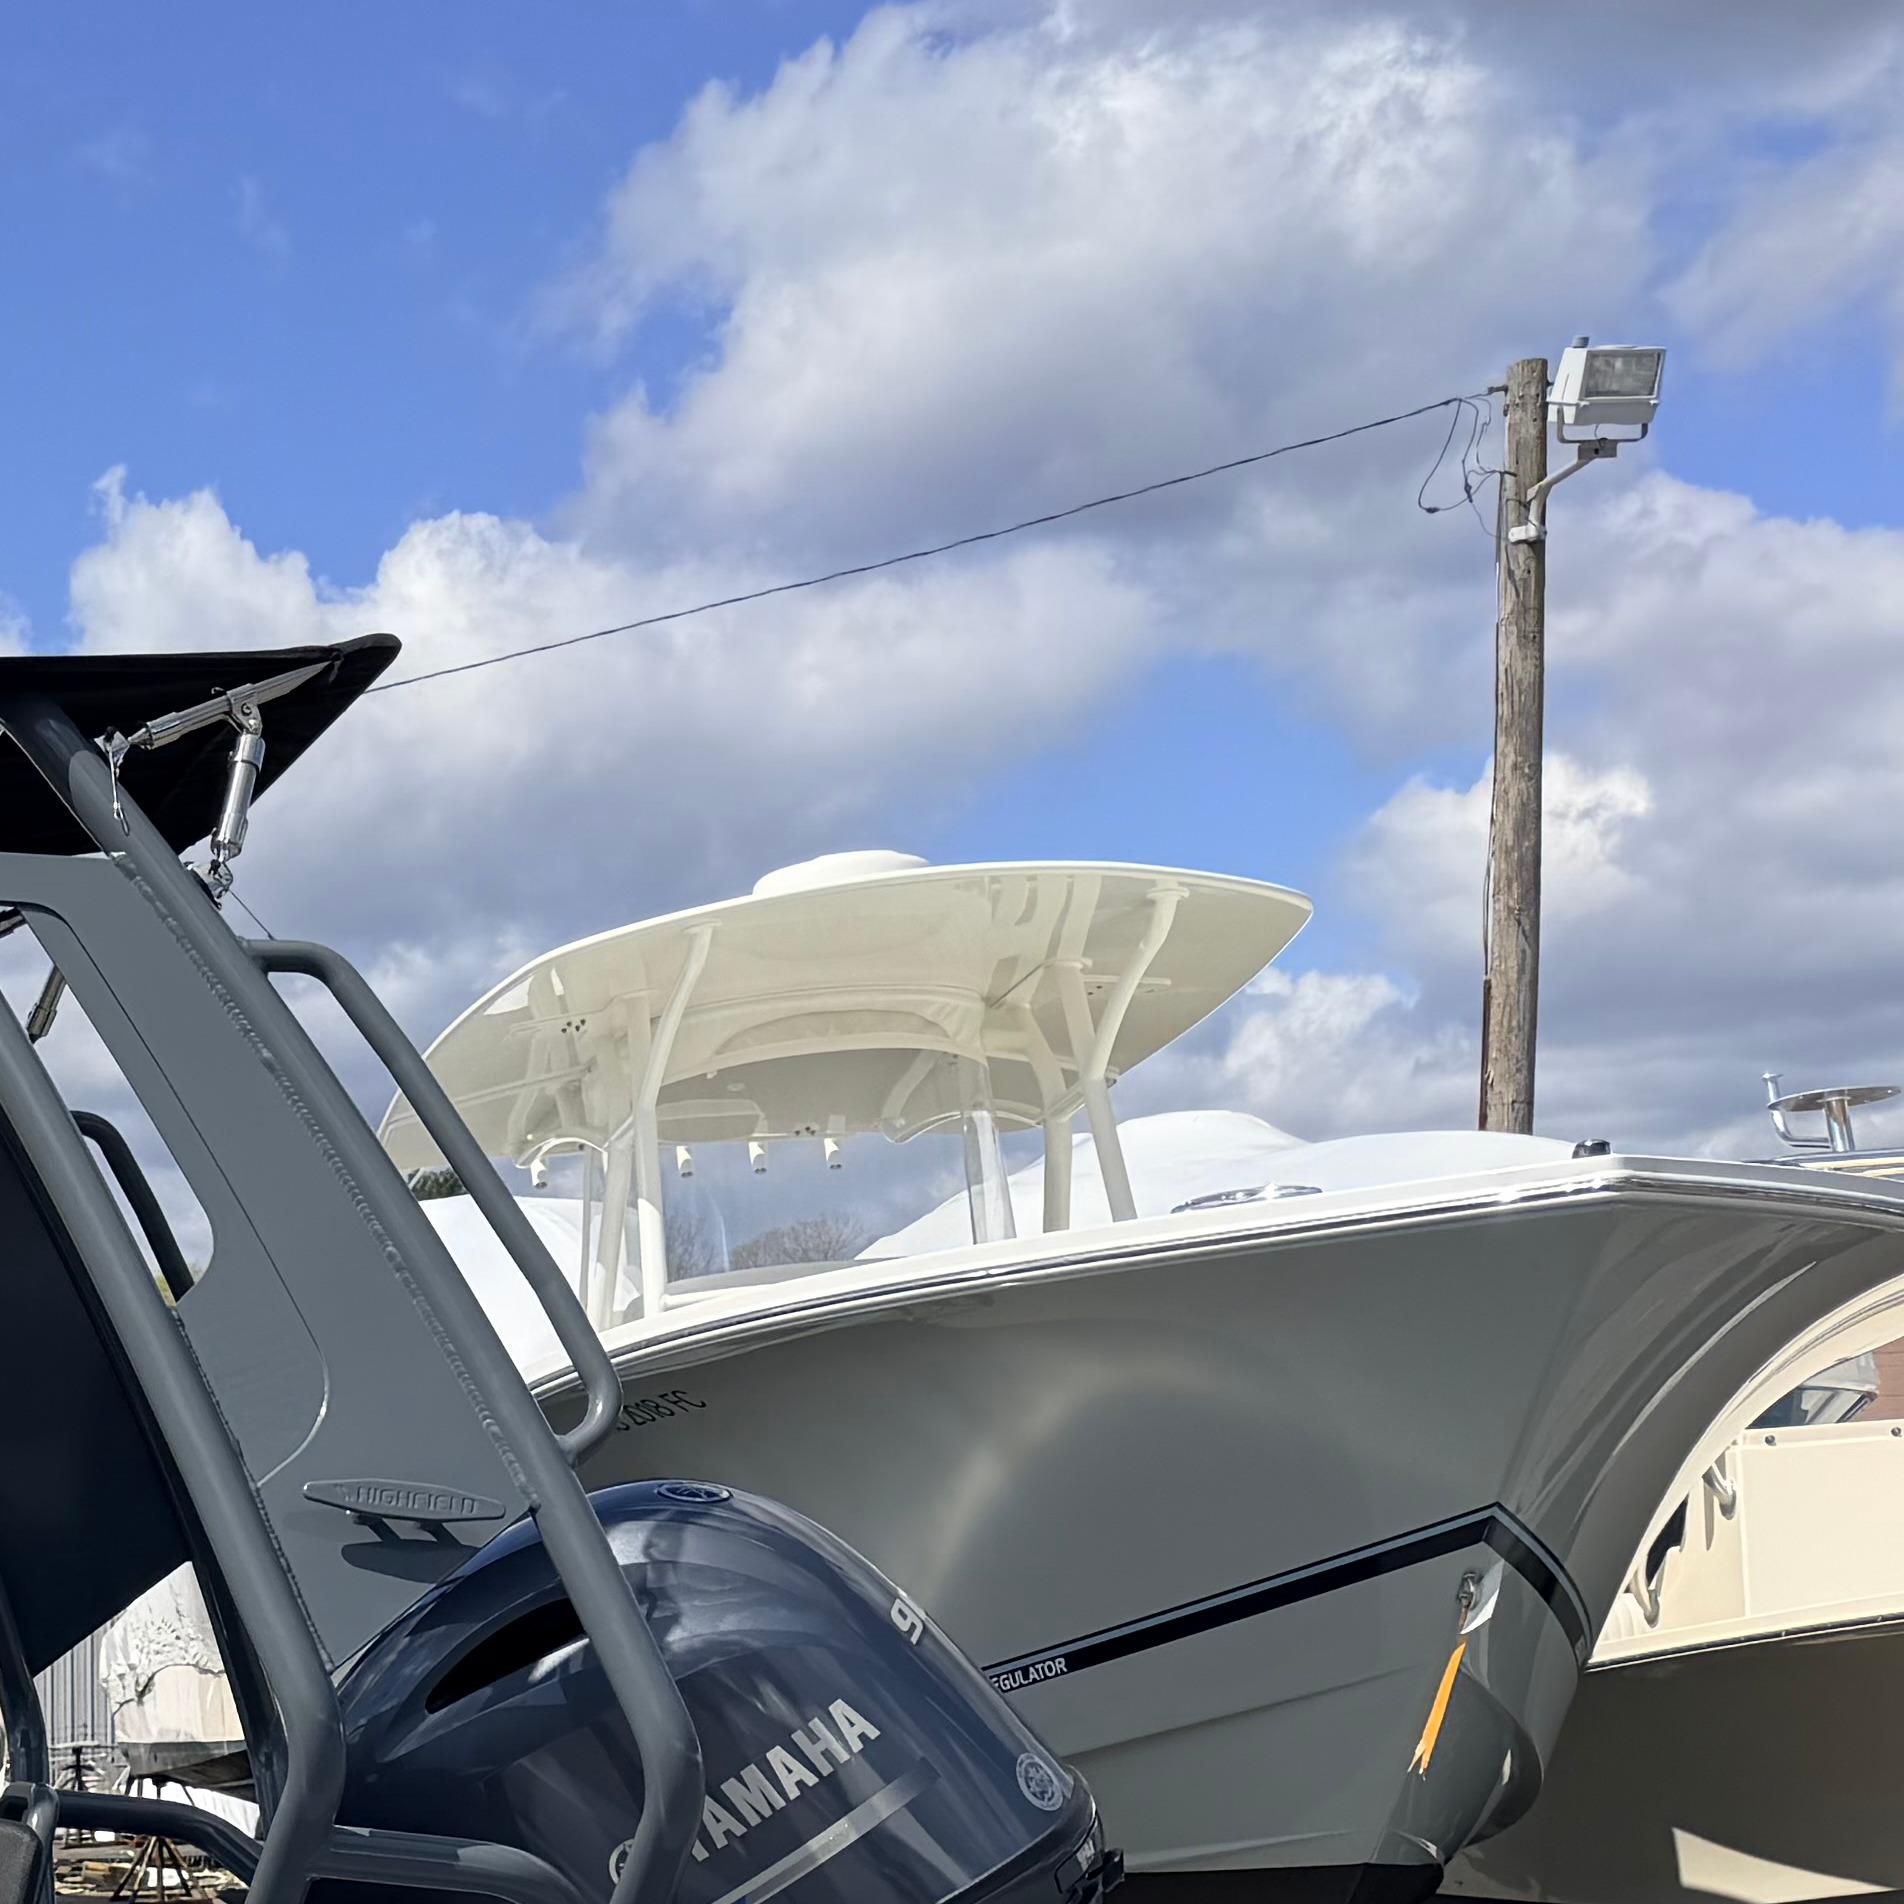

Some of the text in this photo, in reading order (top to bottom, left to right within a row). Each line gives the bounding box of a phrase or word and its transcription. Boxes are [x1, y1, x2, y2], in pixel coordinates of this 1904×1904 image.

[357, 1487, 477, 1514] HIGHFIELD
[991, 1657, 1068, 1692] EGULATOR
[692, 1698, 881, 1862] AMAHA
